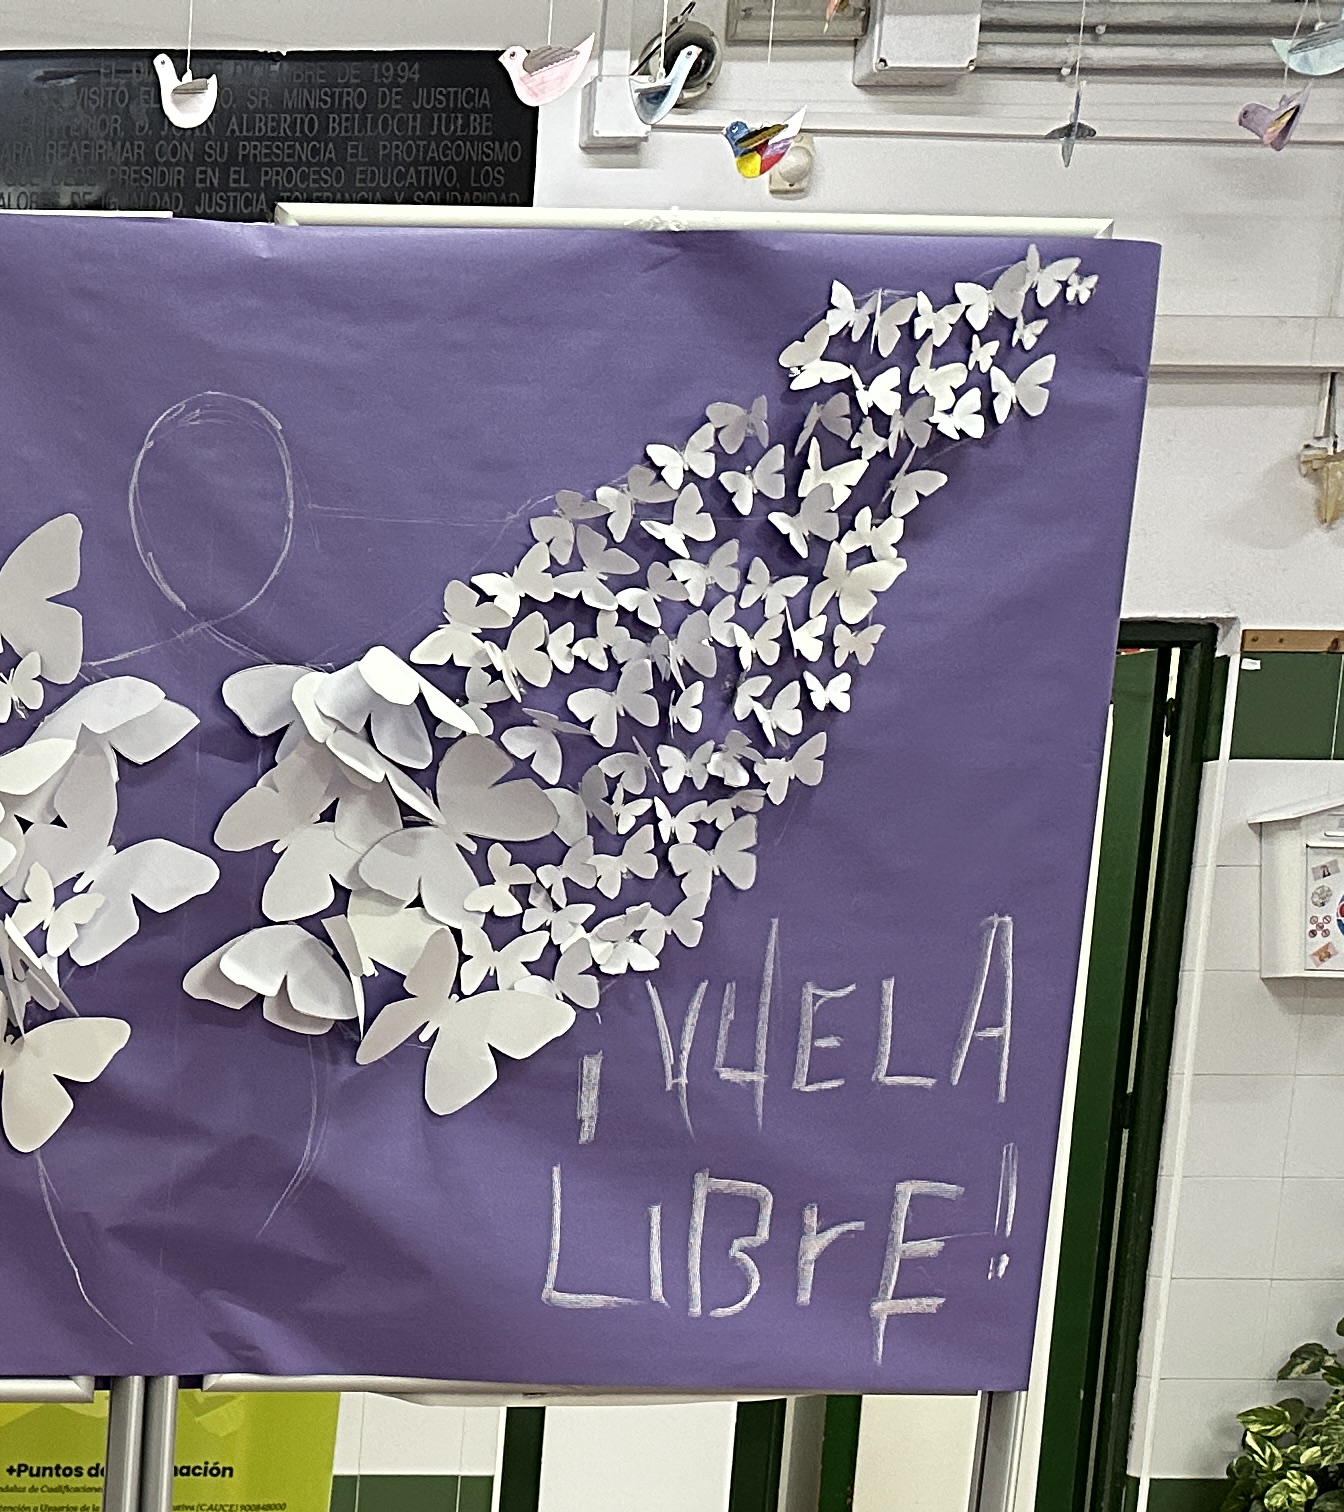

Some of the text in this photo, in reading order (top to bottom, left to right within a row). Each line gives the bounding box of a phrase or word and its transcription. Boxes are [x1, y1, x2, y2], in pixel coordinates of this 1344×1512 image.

[283, 88, 368, 109] MINISTRO
[378, 88, 402, 109] DE
[413, 88, 491, 109] JUSTICIA
[226, 113, 318, 137] ALBERTO
[328, 113, 421, 137] BELLOCH
[46, 141, 522, 163] REAFIRMAR CON SU PRESENCIA EL PROTAGONISMO
[108, 167, 505, 189] PRESIDIR EN EL PROCESO EDUCATIVO, LOS
